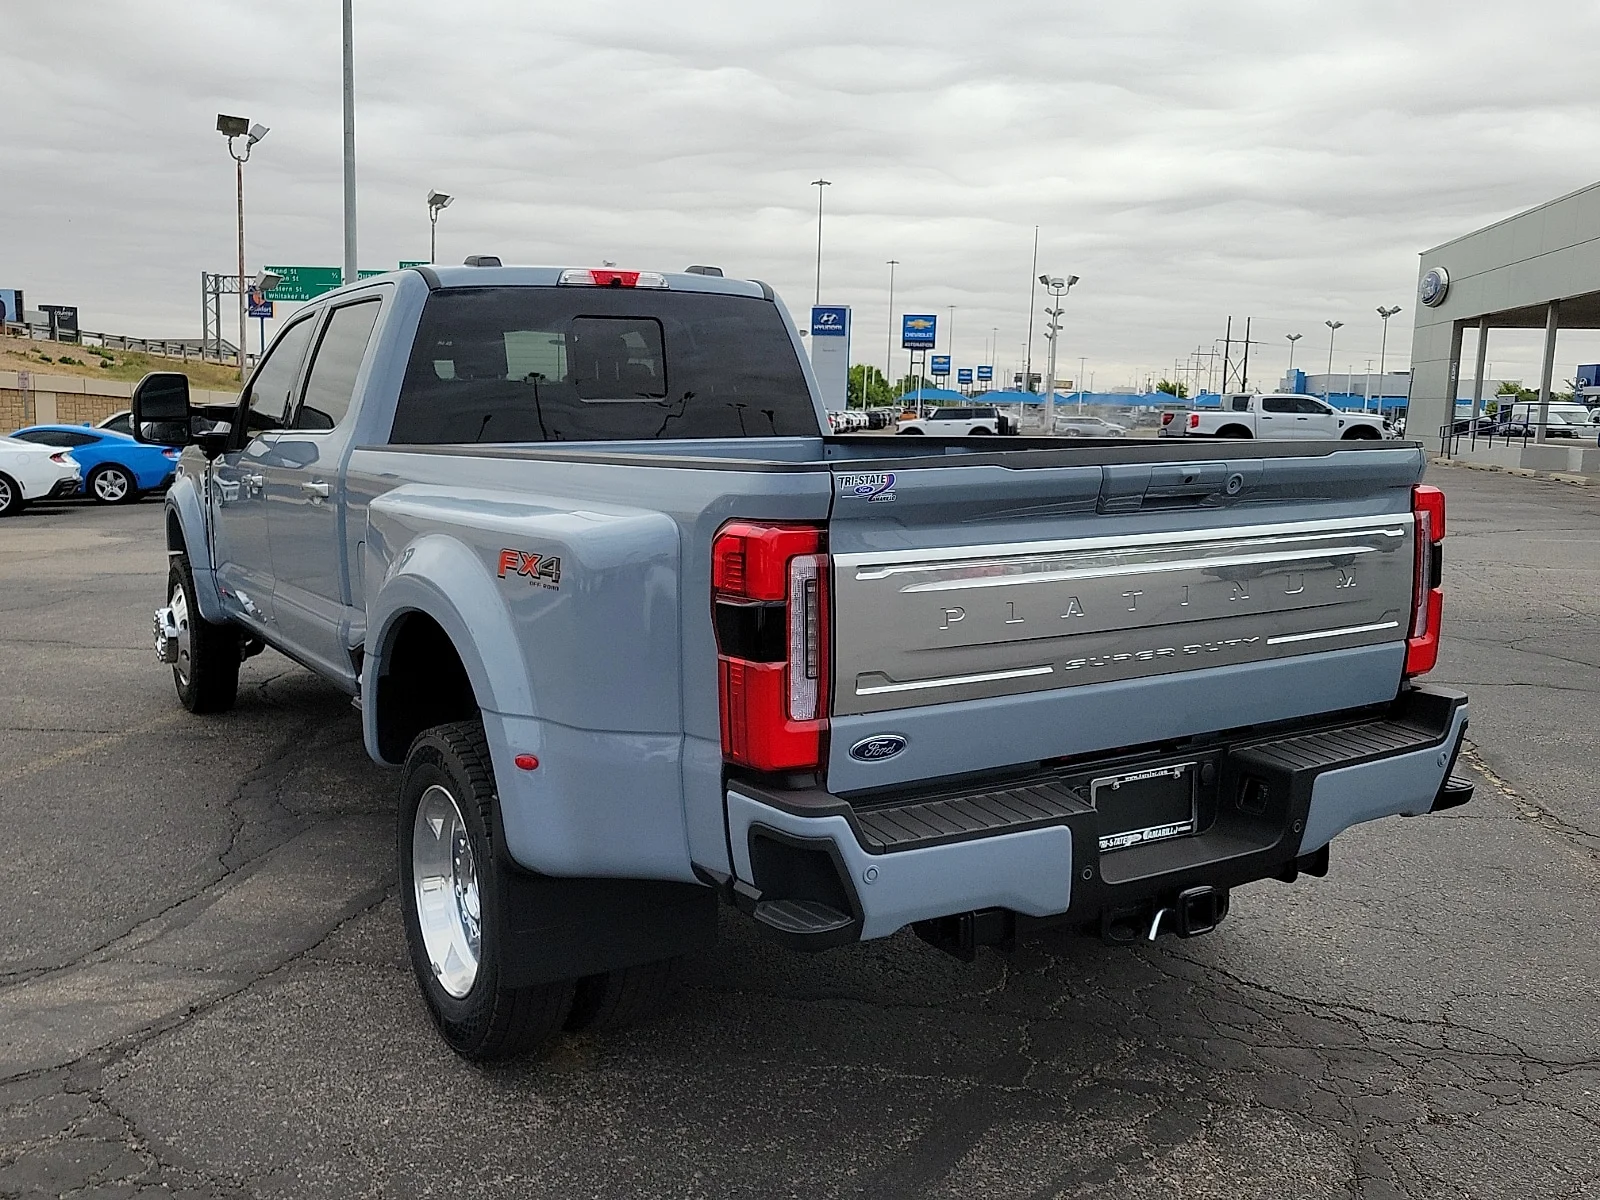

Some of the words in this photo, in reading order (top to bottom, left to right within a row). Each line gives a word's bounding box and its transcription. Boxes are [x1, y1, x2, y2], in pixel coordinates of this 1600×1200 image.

[268, 292, 298, 300] Whitaker
[837, 474, 887, 490] TRI-STATE
[497, 547, 561, 583] FX4
[939, 568, 1357, 630] PLATINUM
[1065, 647, 1176, 670] SUPER
[1182, 636, 1260, 655] DUTY
[864, 740, 896, 757] Ford
